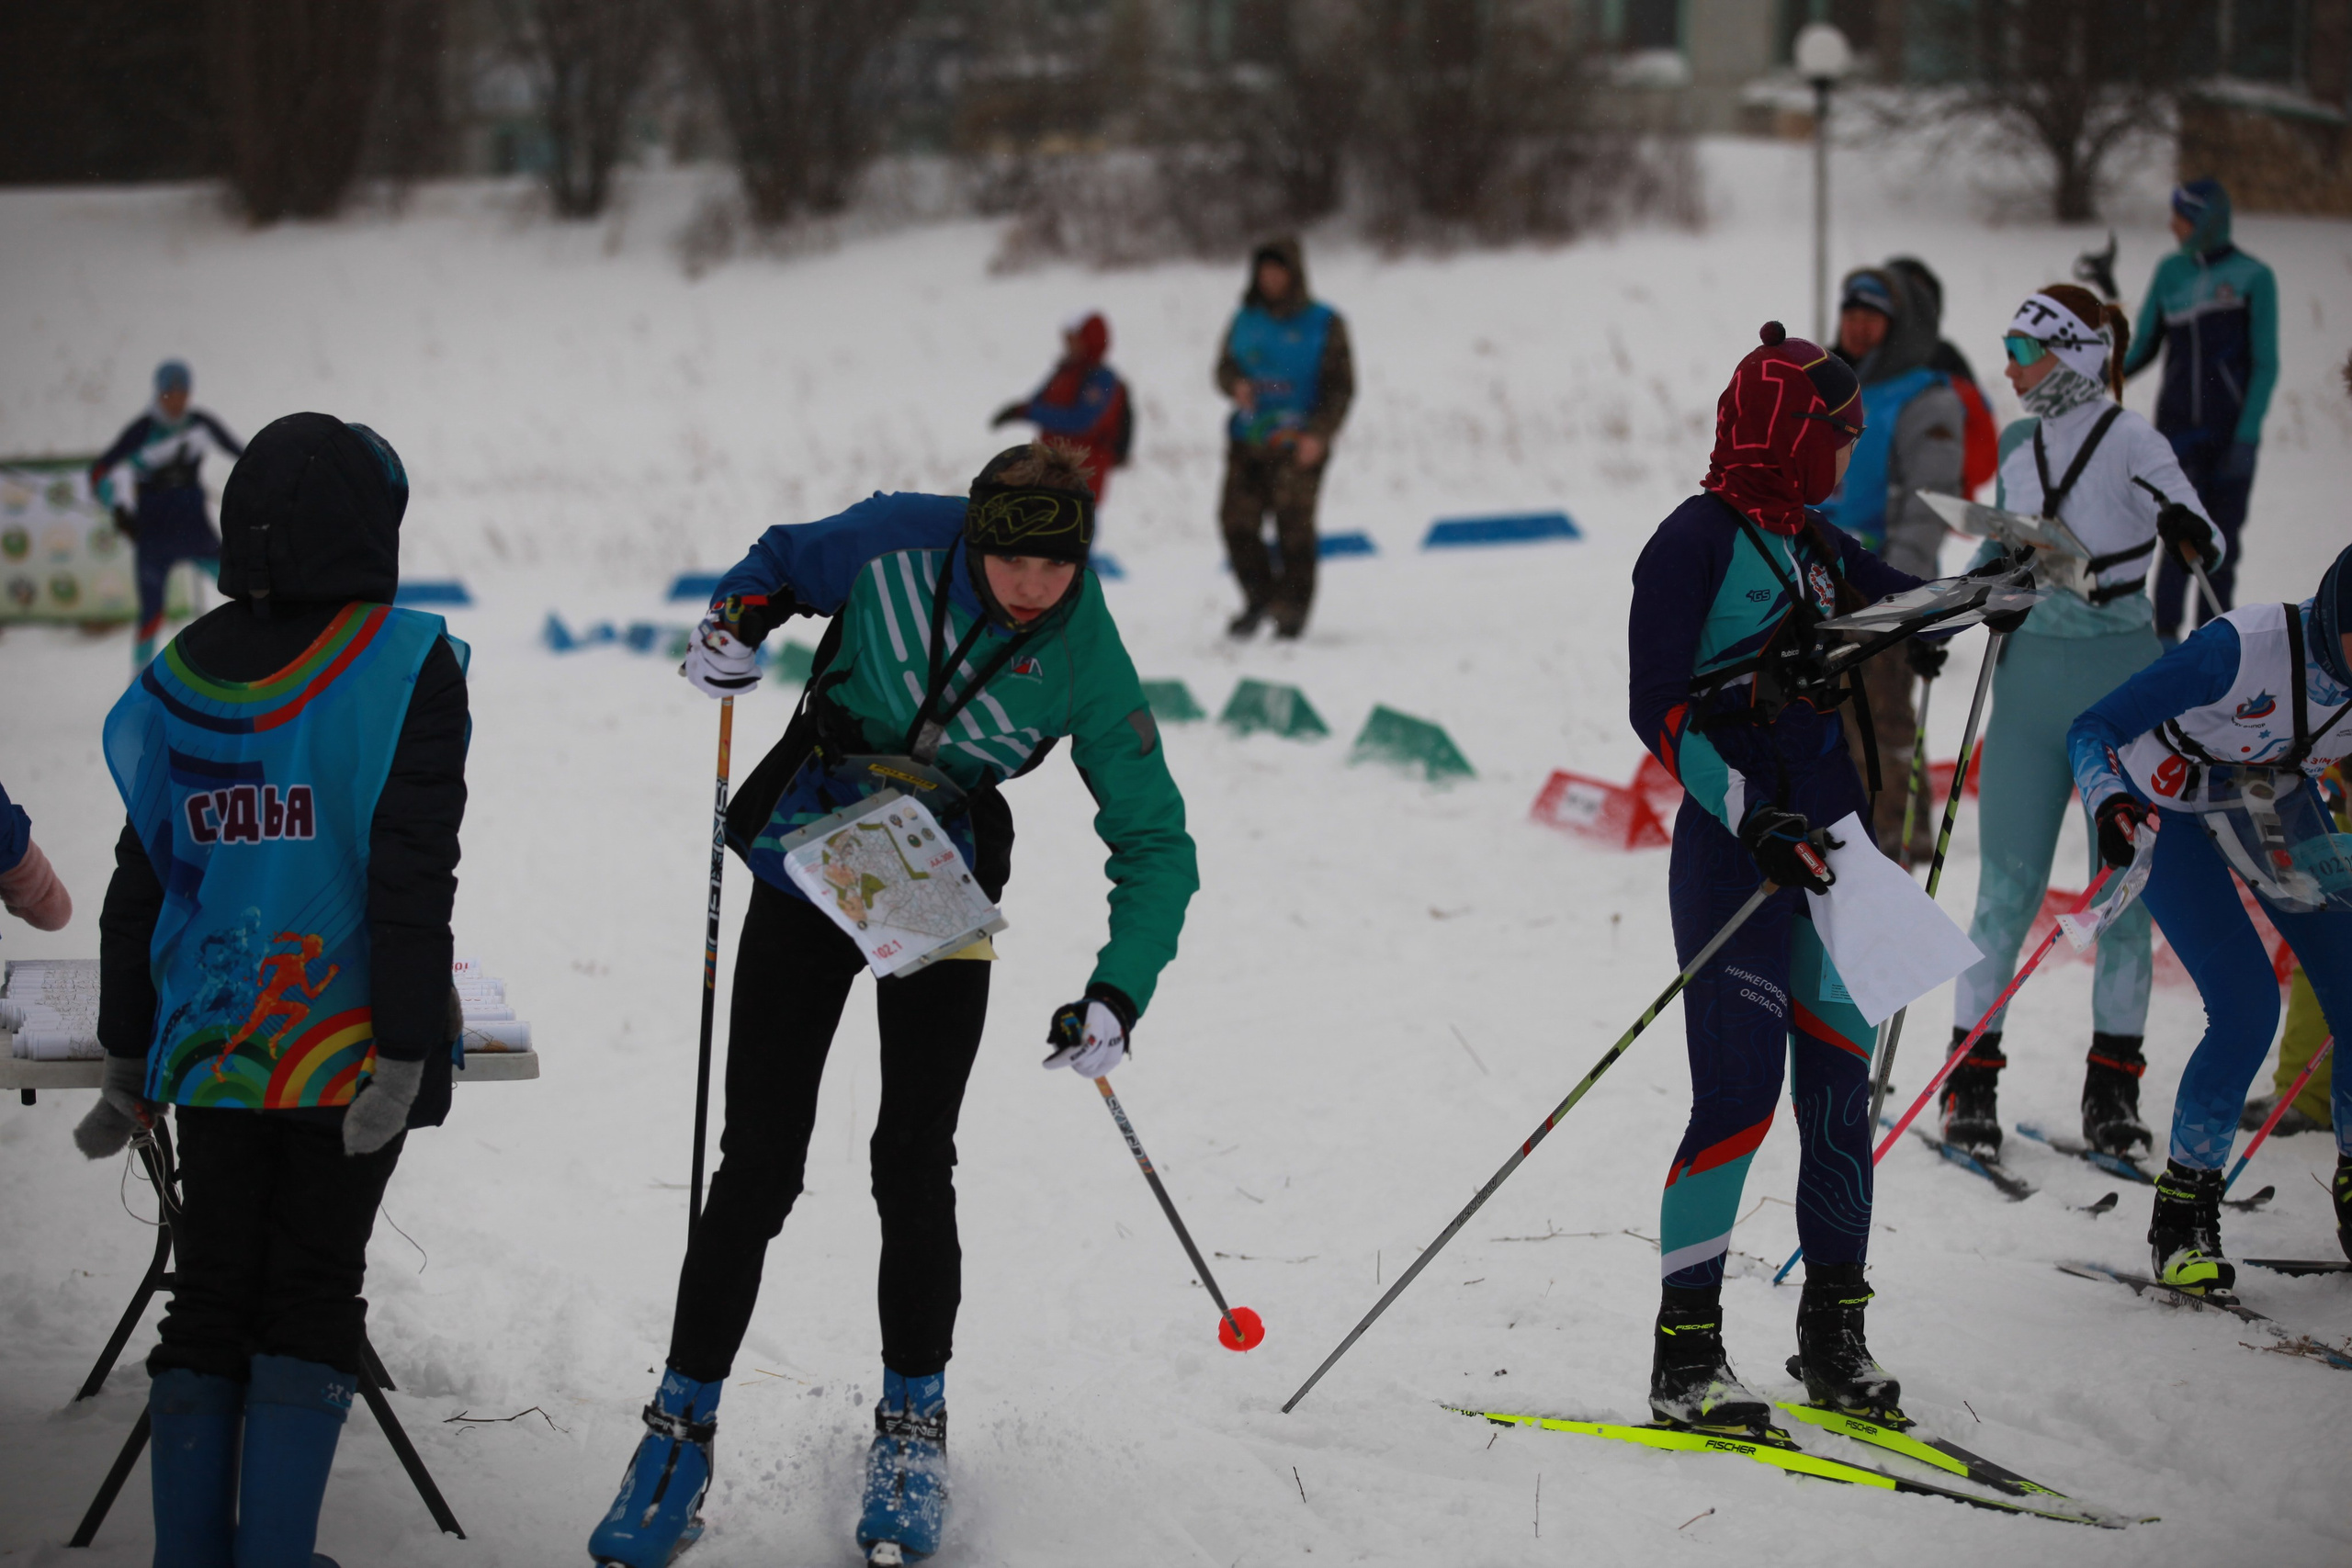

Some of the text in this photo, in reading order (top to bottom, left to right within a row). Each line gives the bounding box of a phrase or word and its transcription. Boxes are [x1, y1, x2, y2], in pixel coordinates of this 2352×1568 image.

[873, 940, 903, 960] 102.1
[1739, 988, 1783, 1019] ОБЛАСТЬ
[1675, 1323, 1715, 1331] FISCHER
[1845, 1419, 1878, 1436] FISCHER
[1705, 1439, 1757, 1456] FISCHER
